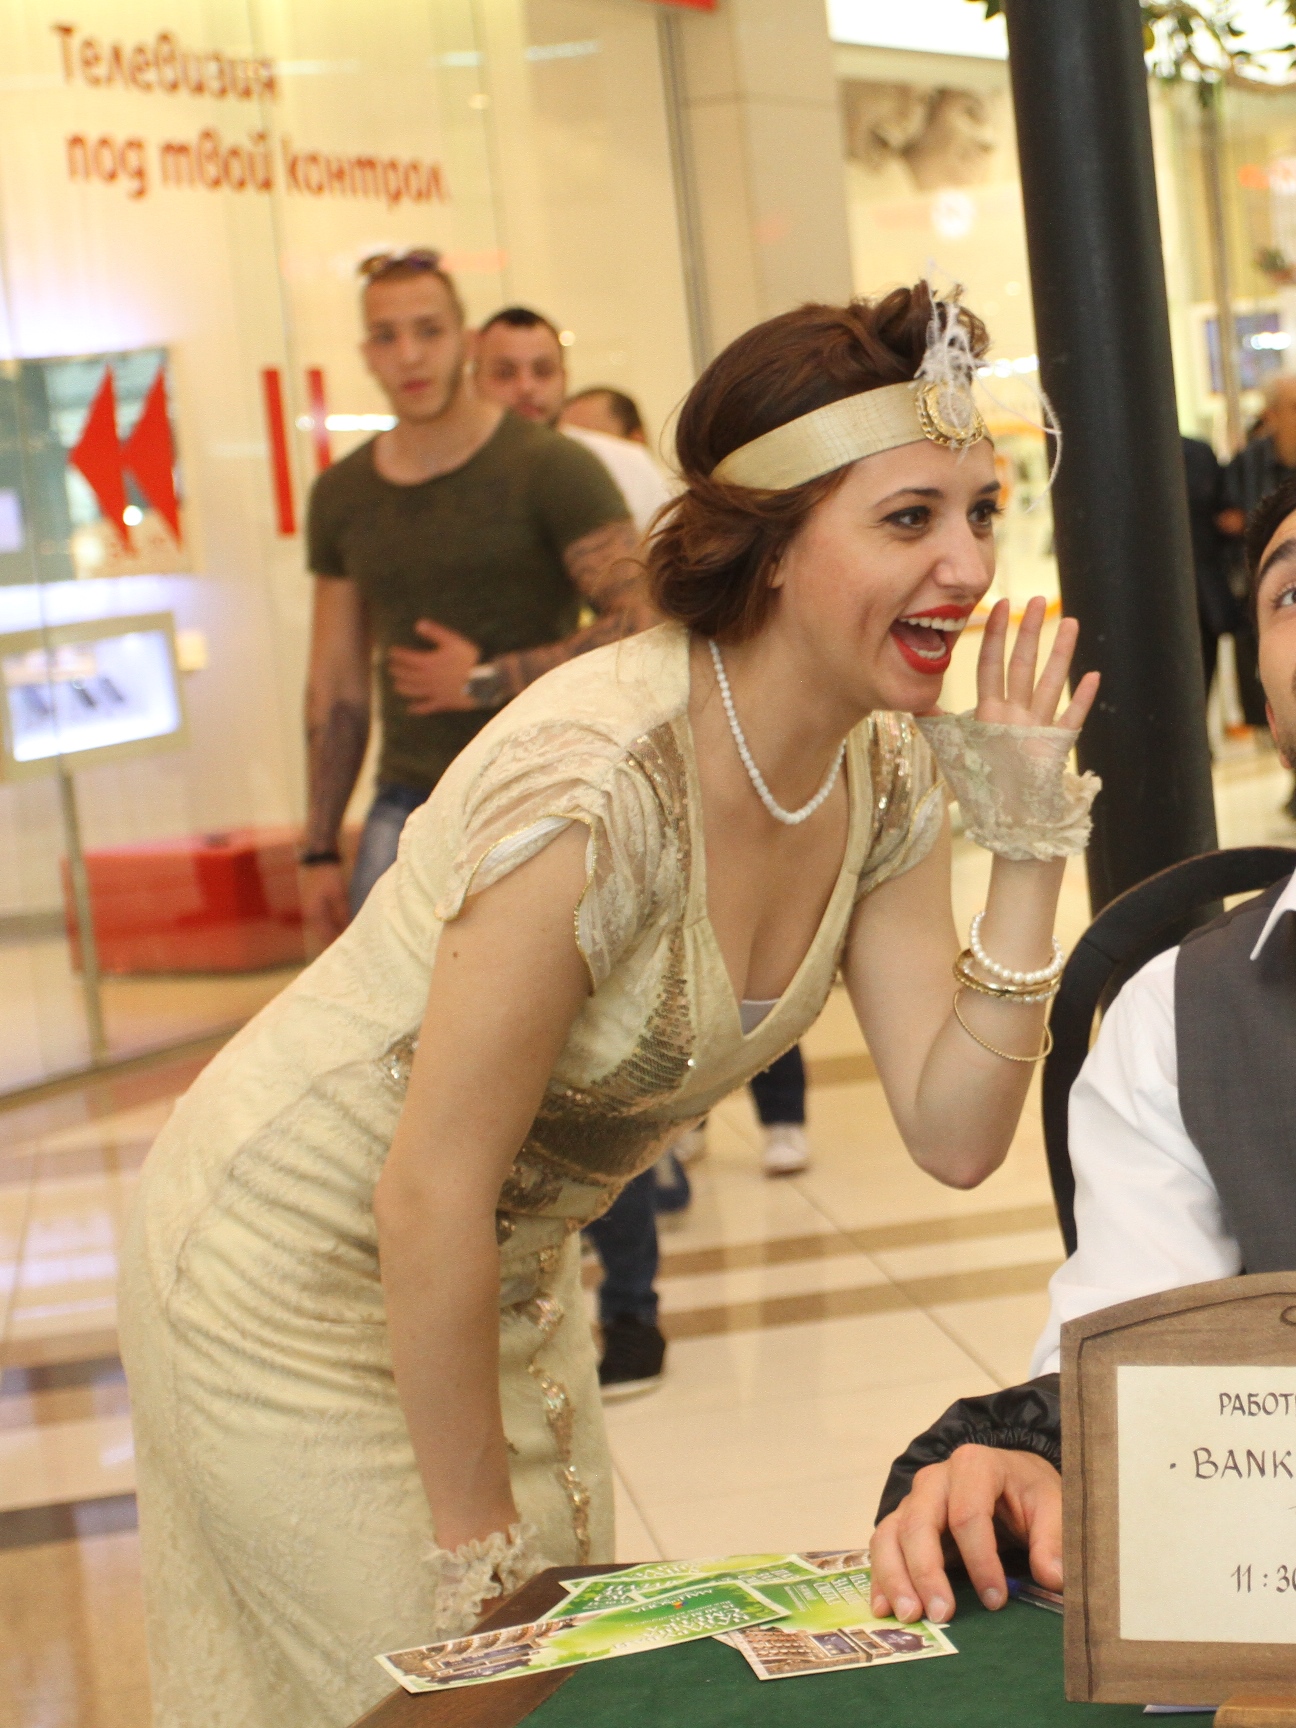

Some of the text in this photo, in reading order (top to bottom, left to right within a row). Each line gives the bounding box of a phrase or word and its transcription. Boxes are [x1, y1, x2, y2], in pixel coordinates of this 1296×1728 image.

[50, 23, 281, 101] Телевизия
[66, 132, 147, 200] под
[1192, 1446, 1294, 1480] BANK
